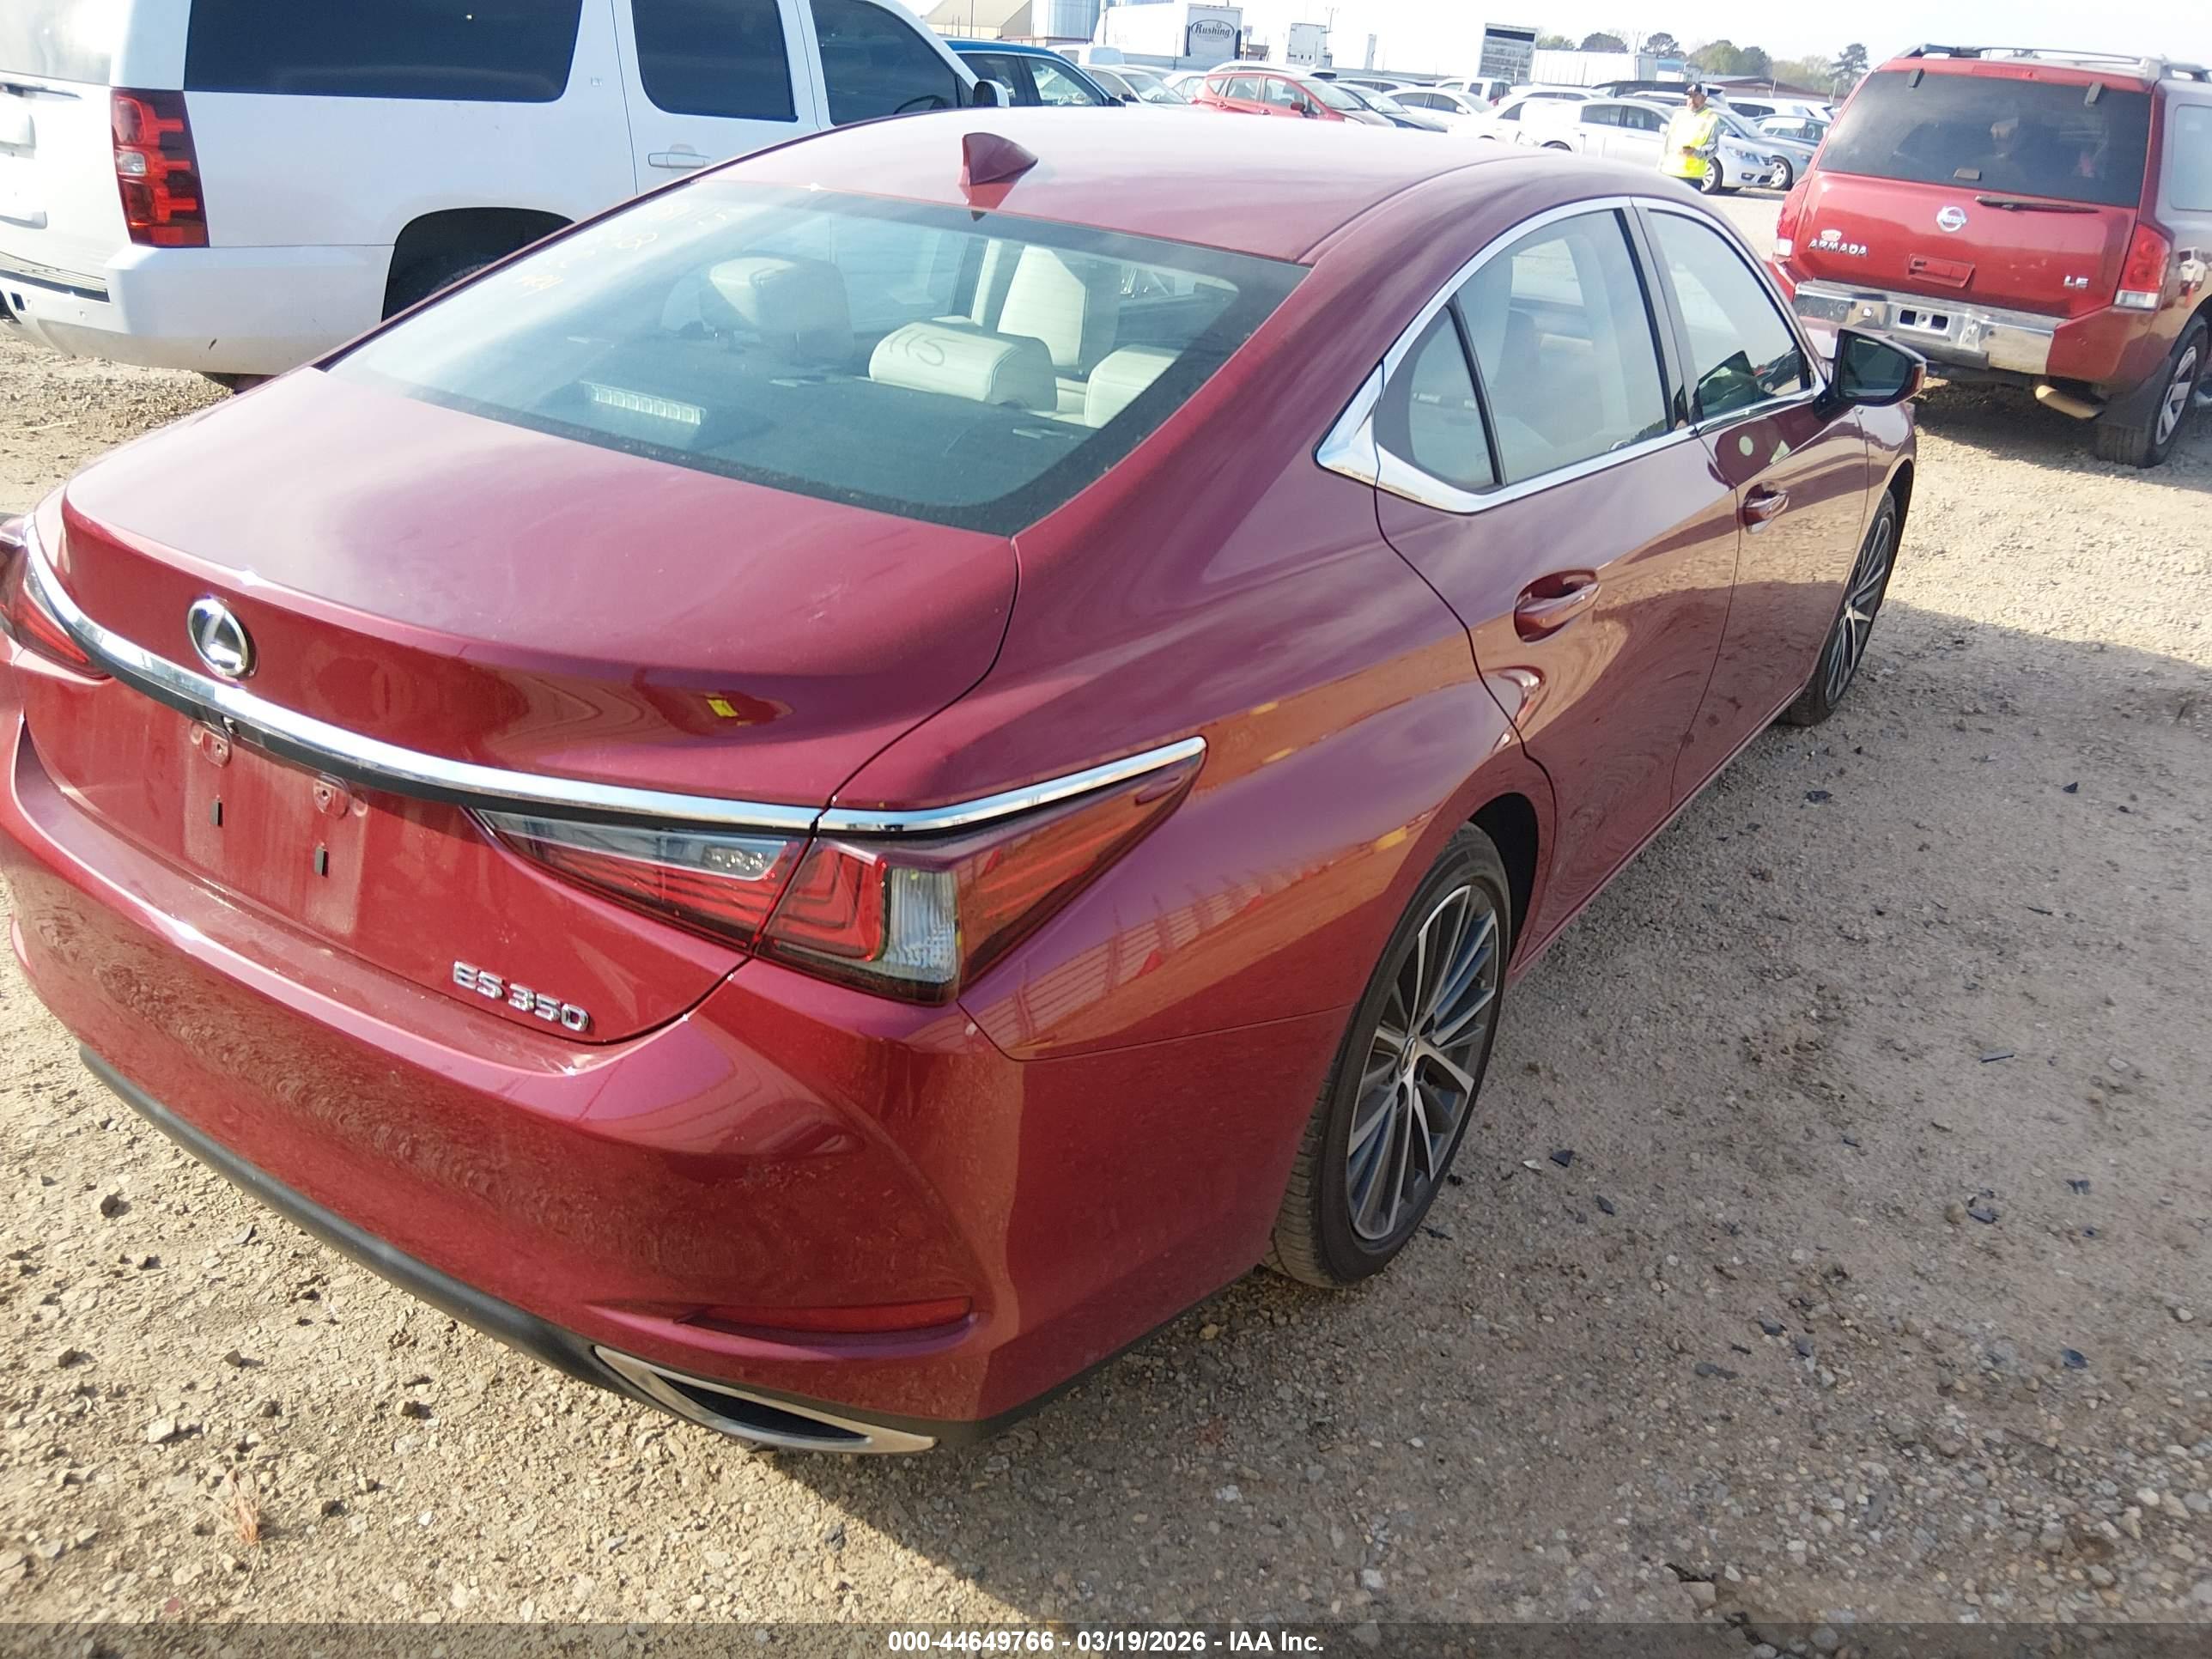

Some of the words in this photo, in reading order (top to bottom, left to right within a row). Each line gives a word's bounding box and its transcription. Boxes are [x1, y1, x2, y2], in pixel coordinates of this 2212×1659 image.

[1194, 22, 1231, 39] Rushing
[1808, 237, 1868, 257] ARMADA
[2063, 275, 2089, 289] LE
[453, 960, 504, 1000] ES
[507, 982, 590, 1032] 350
